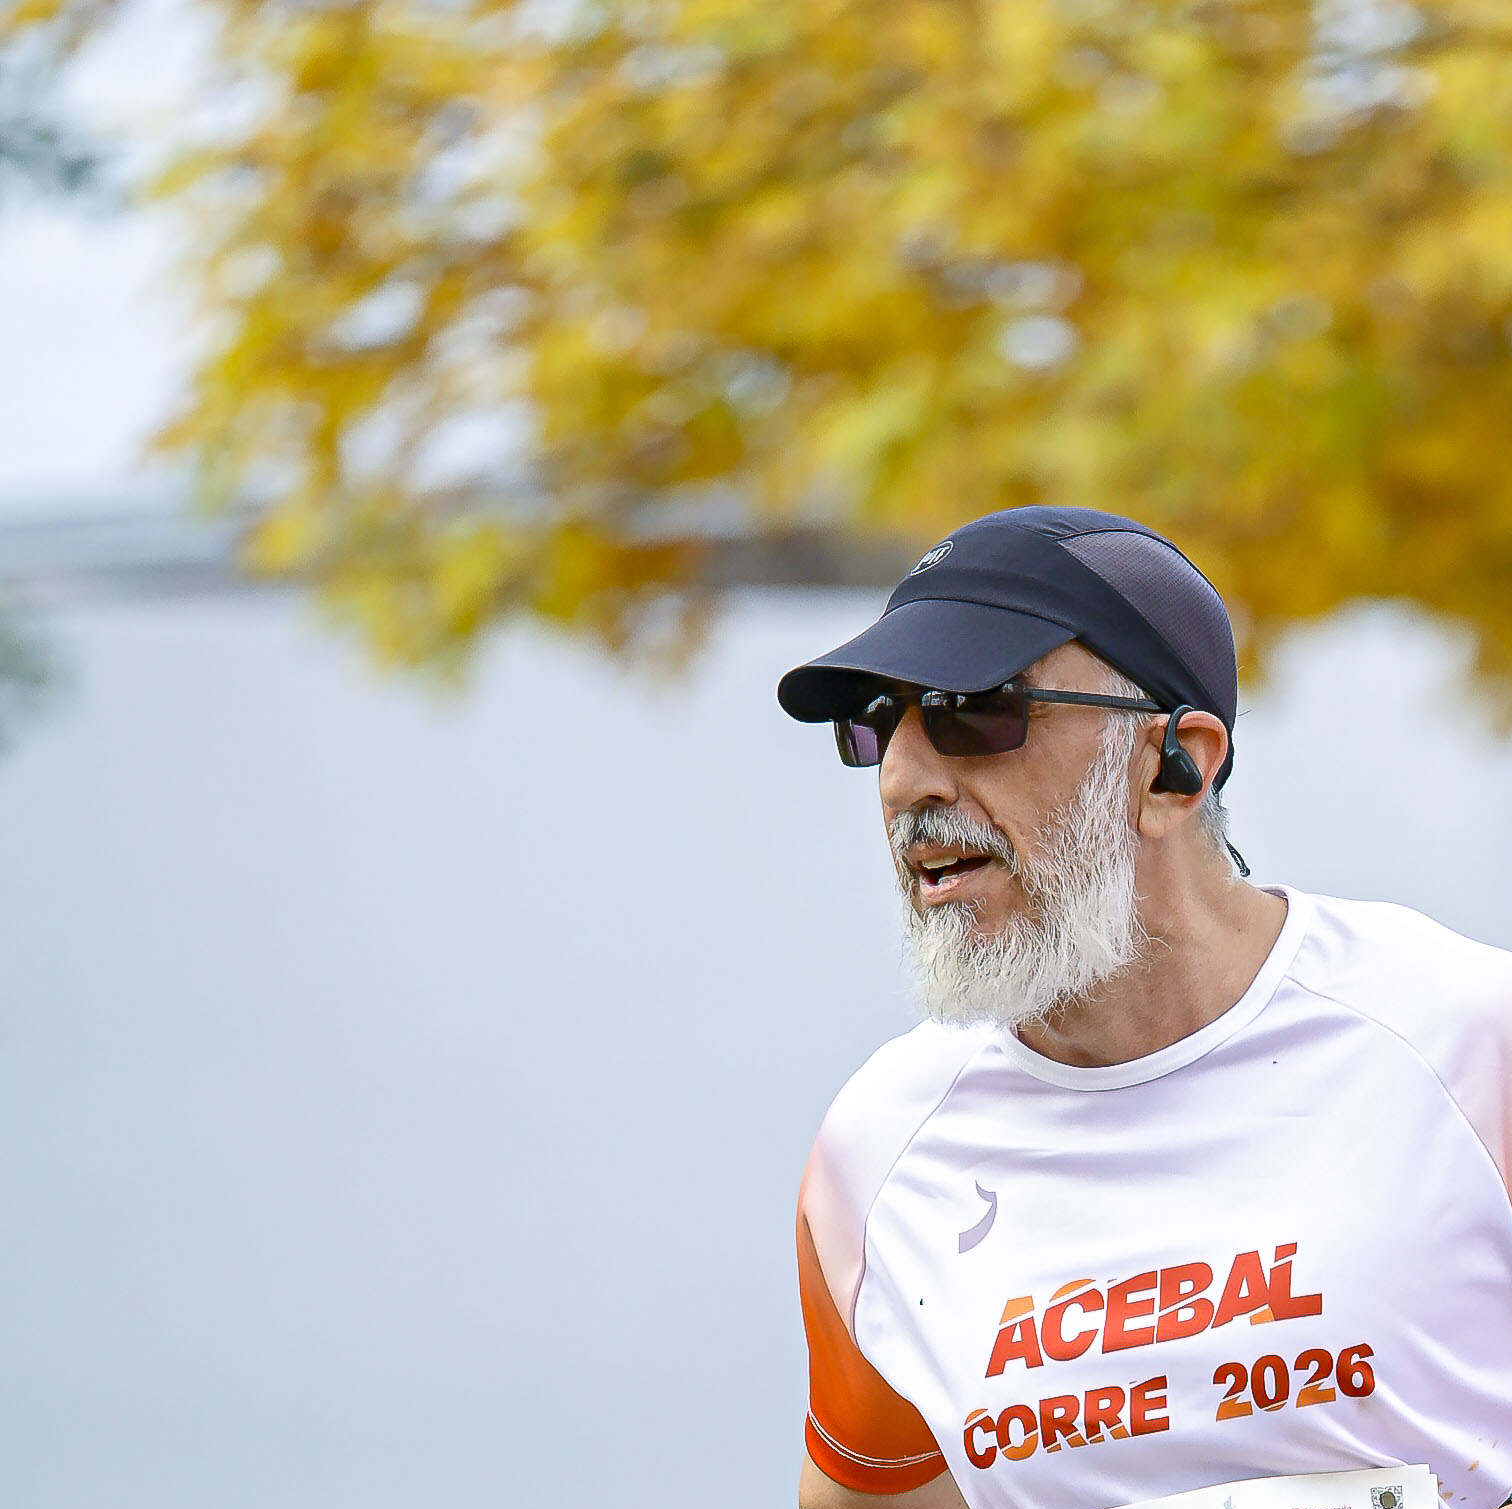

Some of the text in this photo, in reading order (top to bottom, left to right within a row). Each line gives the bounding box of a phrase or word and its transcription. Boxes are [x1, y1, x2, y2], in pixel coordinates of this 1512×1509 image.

[985, 1242, 1323, 1378] ACEBAL
[963, 1343, 1376, 1470] CORRE 2026
